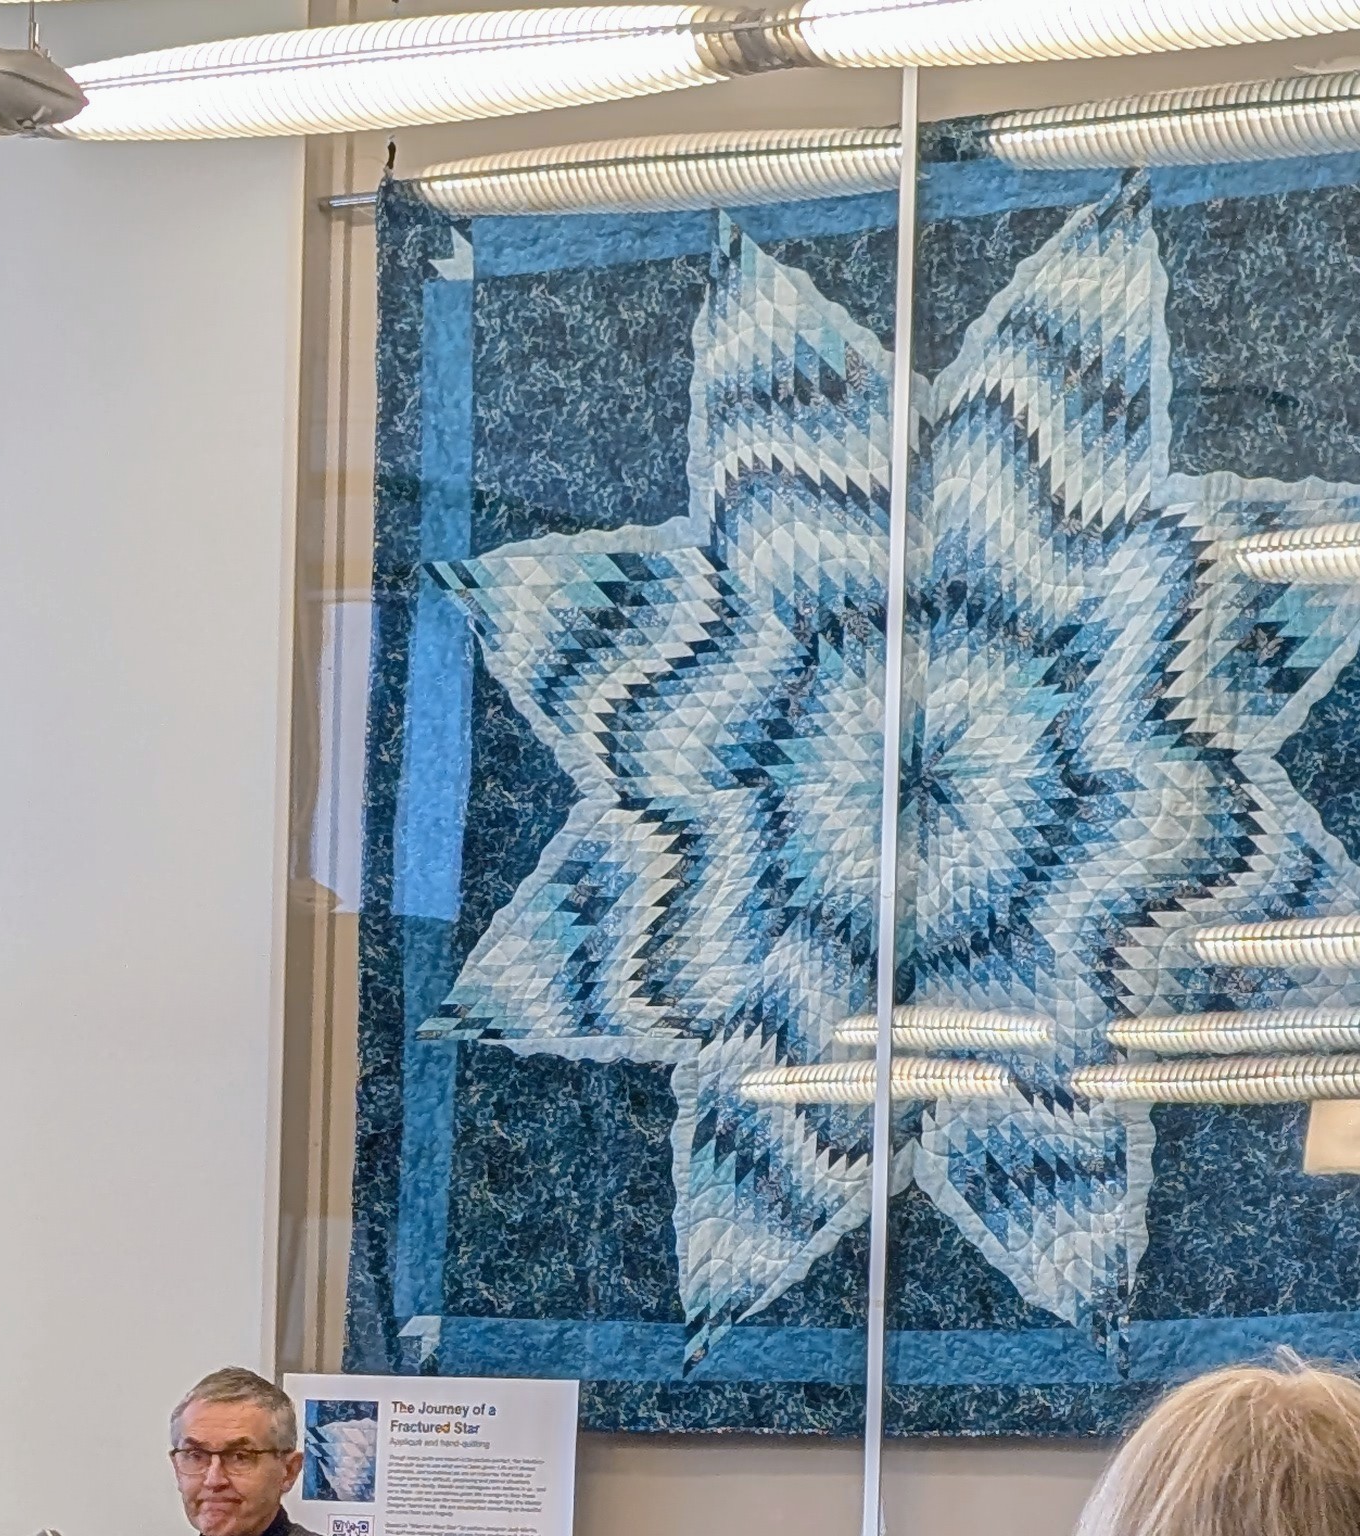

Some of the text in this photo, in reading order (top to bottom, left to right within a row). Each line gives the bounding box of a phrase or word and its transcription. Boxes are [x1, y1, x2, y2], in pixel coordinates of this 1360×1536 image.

[392, 1401, 497, 1418] The Journey of a
[390, 1420, 481, 1435] Fractured Star
